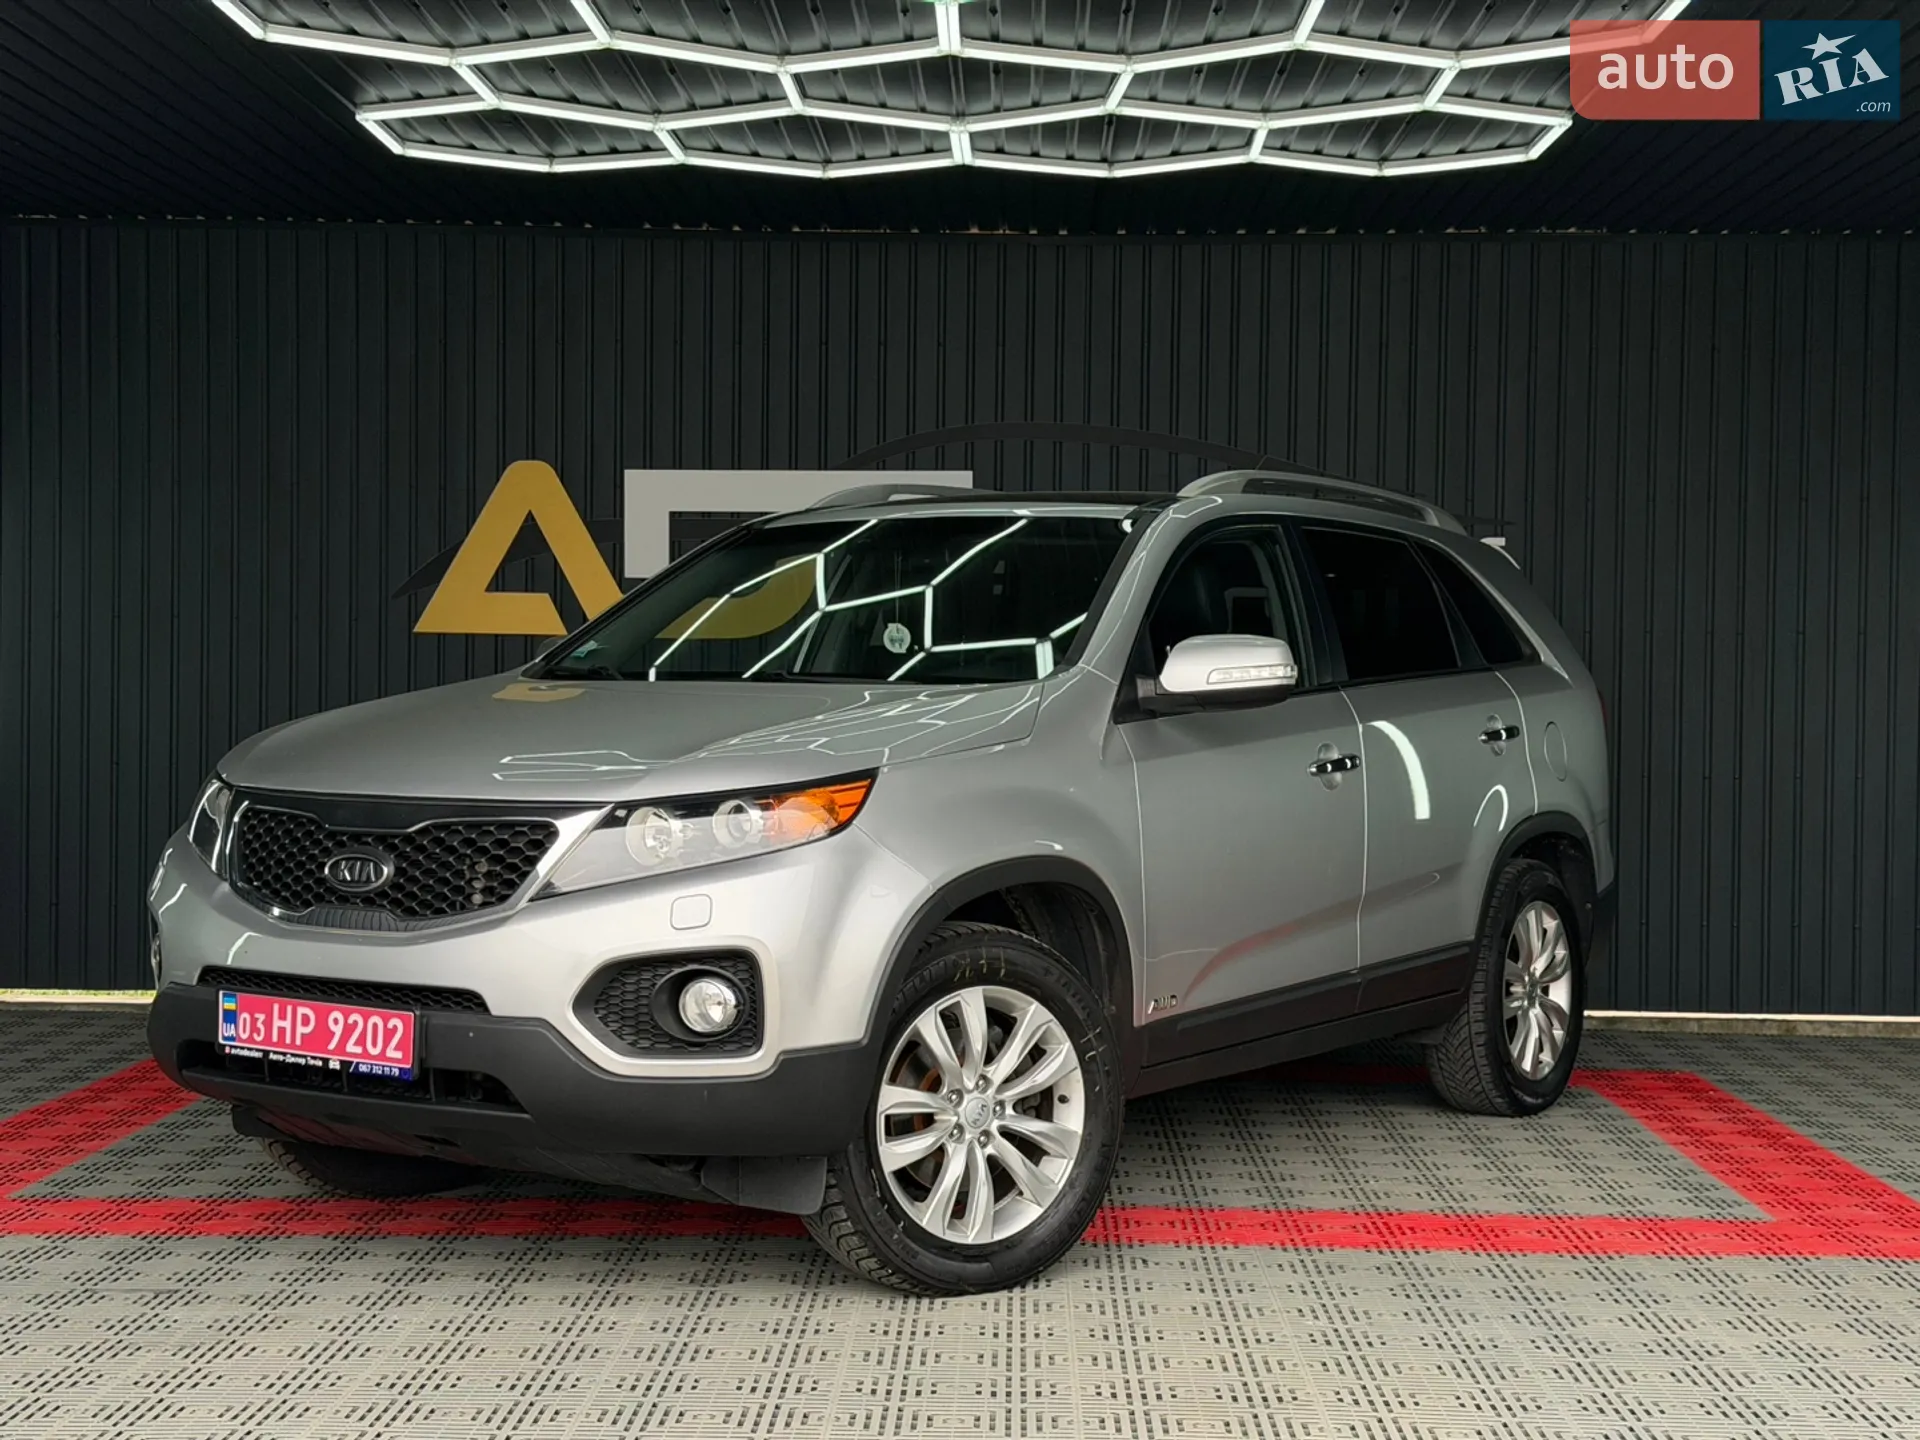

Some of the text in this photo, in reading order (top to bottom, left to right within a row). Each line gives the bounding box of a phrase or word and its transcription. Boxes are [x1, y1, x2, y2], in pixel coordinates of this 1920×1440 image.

[338, 860, 376, 882] KIA
[1147, 994, 1179, 1014] AWD
[222, 1022, 236, 1037] UA
[239, 1002, 404, 1059] 03 HP 9202
